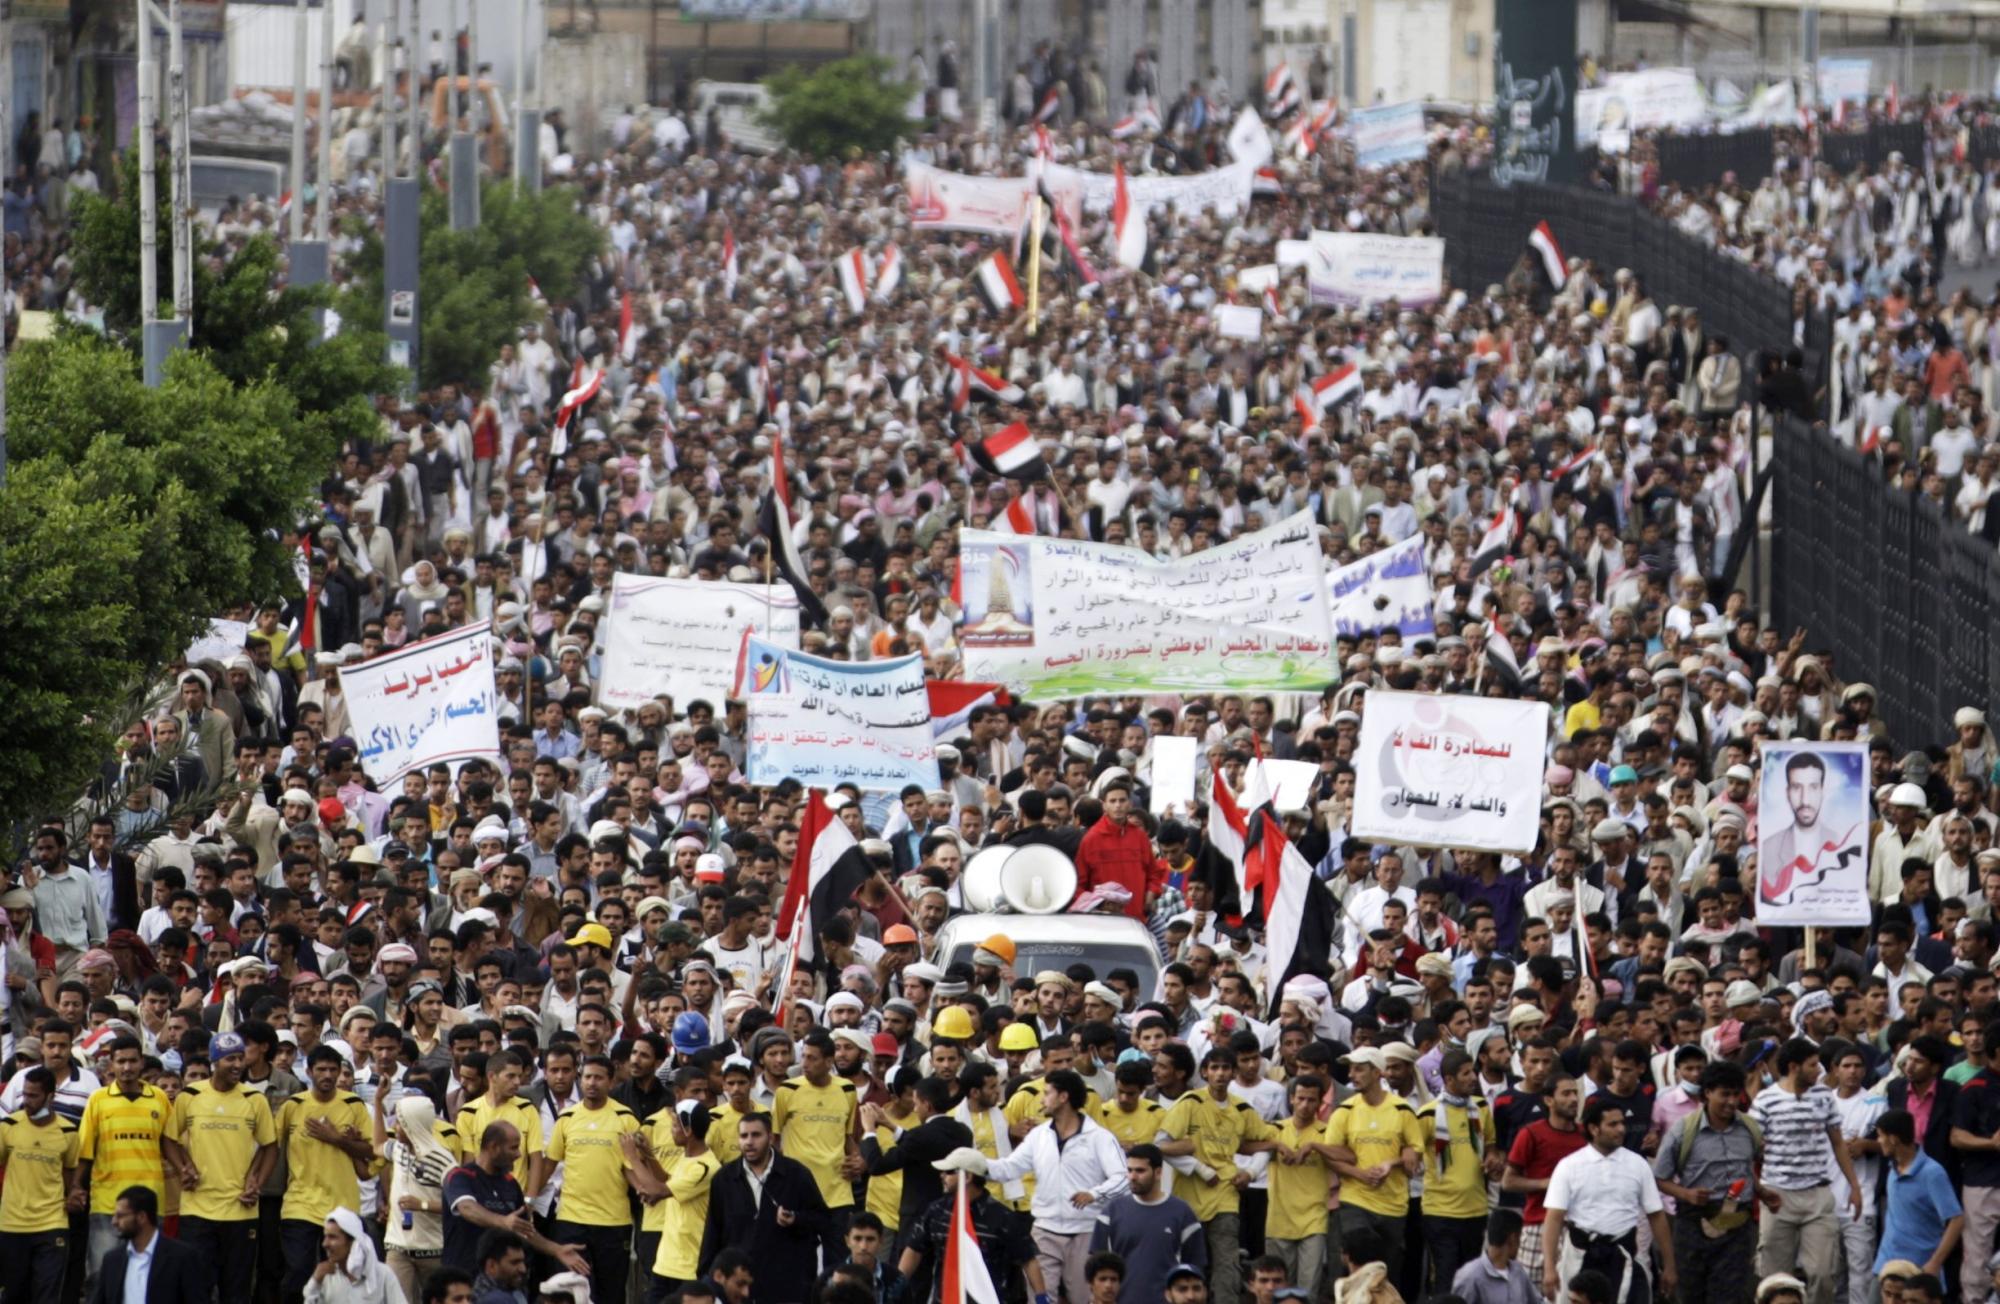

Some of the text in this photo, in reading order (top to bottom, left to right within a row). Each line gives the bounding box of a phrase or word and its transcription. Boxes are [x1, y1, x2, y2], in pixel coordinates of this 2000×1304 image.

[1043, 648, 1092, 671] الحسم
[1097, 639, 1153, 661] بضرورة
[1159, 635, 1213, 661] الوطني
[435, 637, 490, 686] الشعب
[800, 692, 823, 710] الله
[850, 683, 893, 699] العالم
[443, 690, 495, 728] الحسم
[1443, 735, 1512, 759] للمبادرة
[1390, 787, 1440, 808] للحوار
